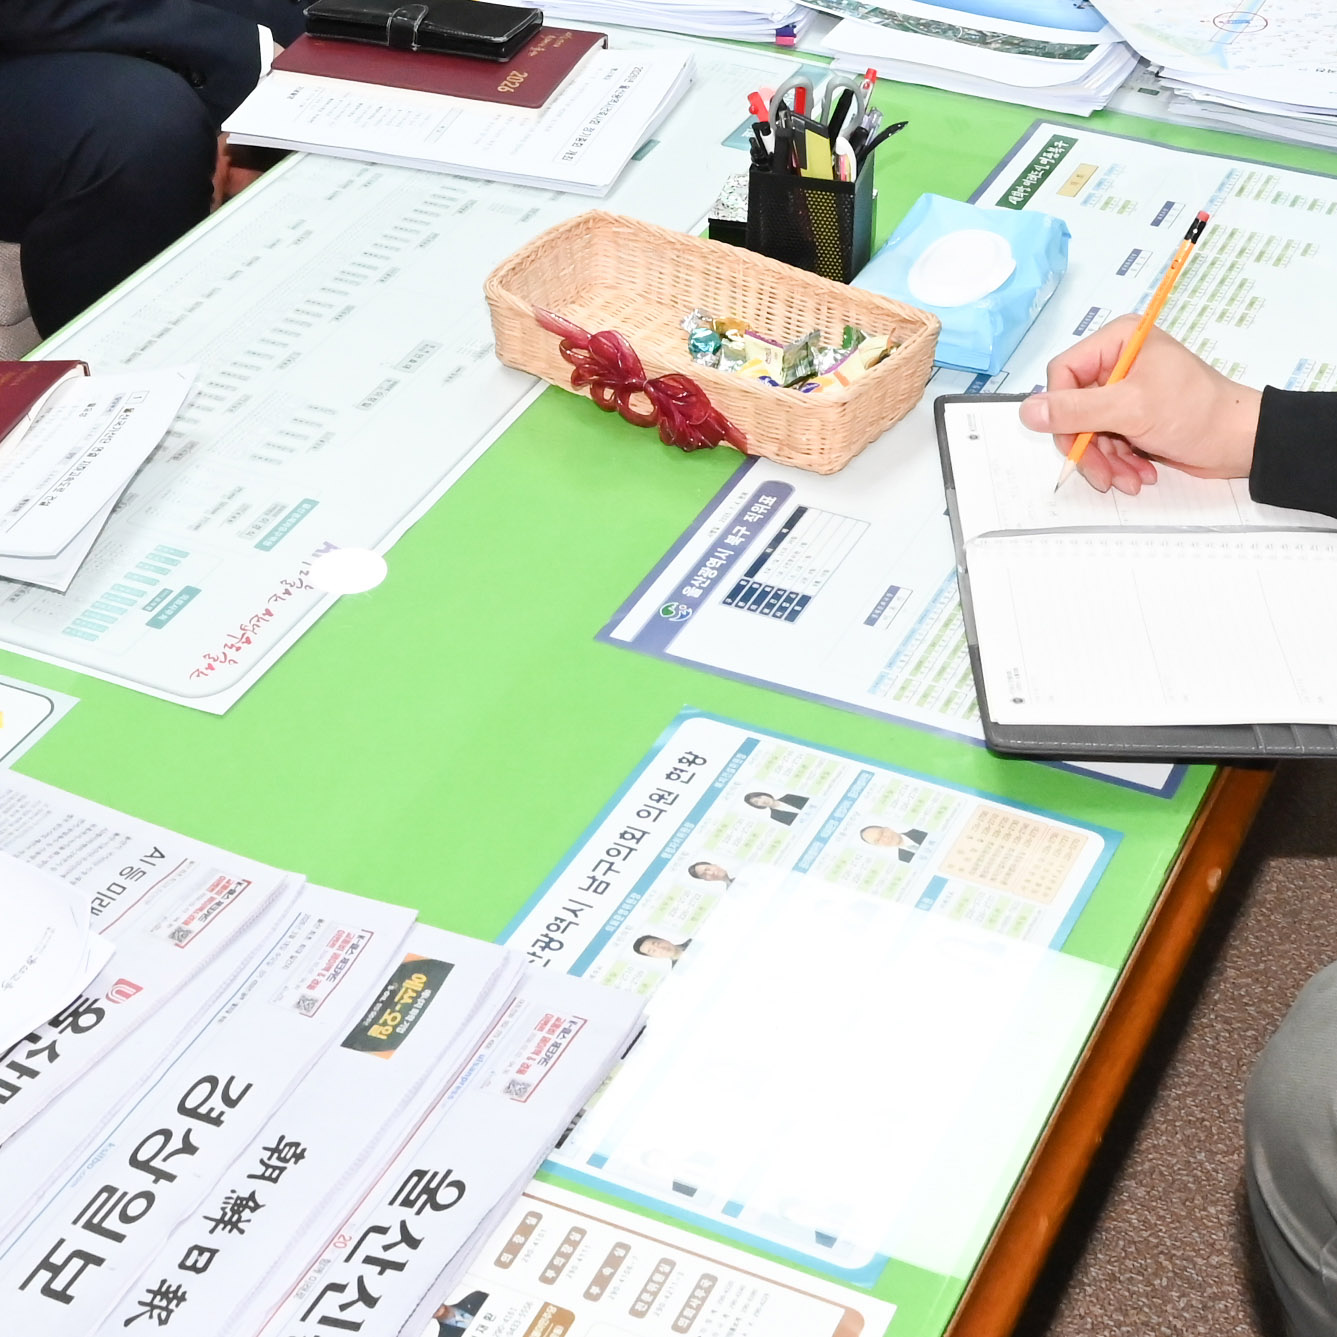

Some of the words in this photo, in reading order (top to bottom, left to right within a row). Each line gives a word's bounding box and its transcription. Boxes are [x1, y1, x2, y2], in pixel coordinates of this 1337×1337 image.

[496, 69, 529, 94] 2026
[682, 546, 735, 599] 울산광역시
[724, 525, 752, 547] 북구
[742, 494, 778, 525] 직위표
[577, 824, 649, 897] 남구의회
[635, 786, 680, 825] 의원
[665, 749, 708, 785] 현황
[139, 846, 165, 867] AI
[118, 865, 147, 883] 등
[199, 900, 224, 923] 체크카드
[325, 957, 350, 984] 체크카드
[366, 972, 428, 1041] 에쓰-오일
[536, 1040, 562, 1067] 체크카드
[17, 1073, 254, 1306] 경상일보
[122, 1134, 308, 1327] 朝鮮日報
[330, 1233, 353, 1251] 20
[299, 1167, 466, 1335] 울산신
